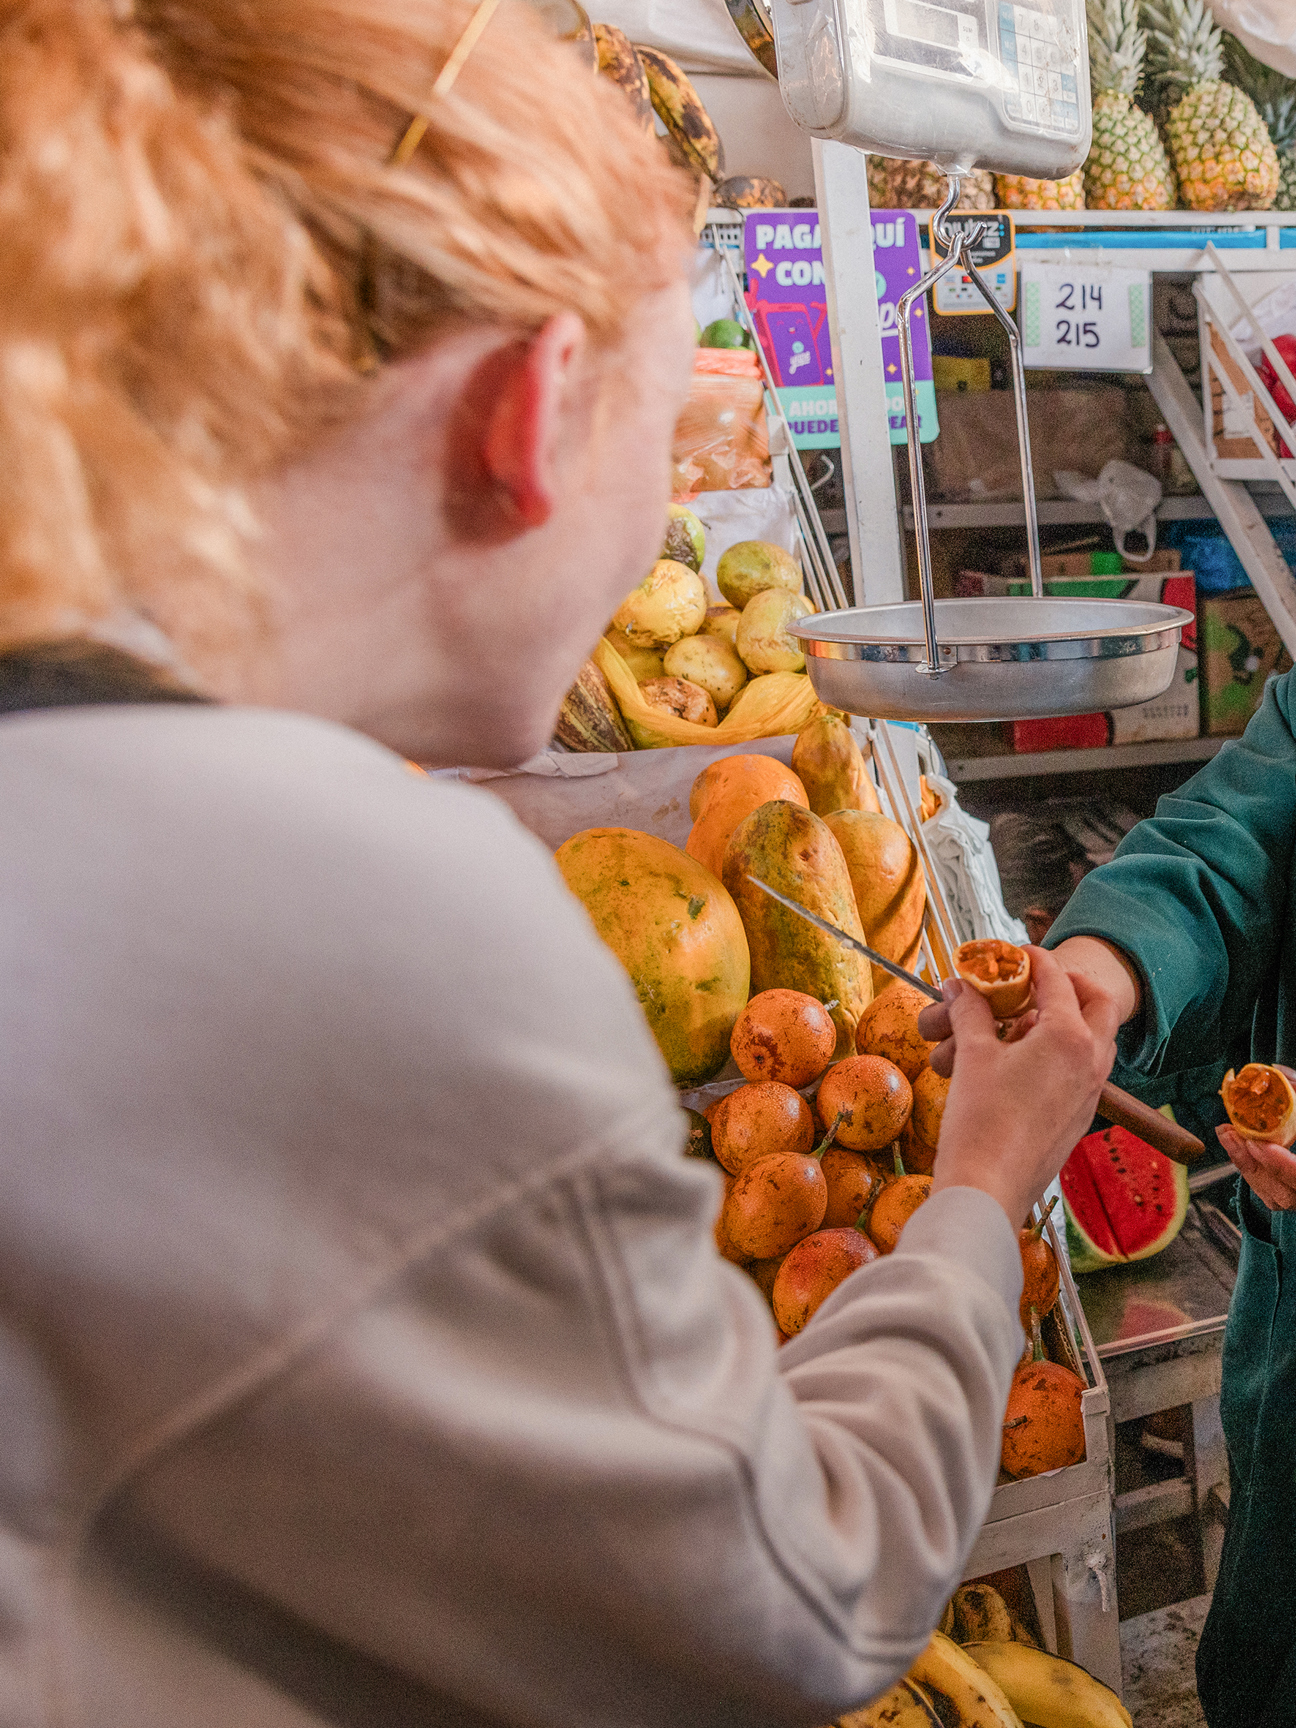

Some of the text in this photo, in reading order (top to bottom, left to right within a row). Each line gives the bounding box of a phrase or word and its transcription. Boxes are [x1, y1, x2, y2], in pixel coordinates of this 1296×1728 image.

[871, 216, 906, 250] UÍ
[1055, 283, 1102, 310] 214
[1056, 320, 1100, 348] 215
